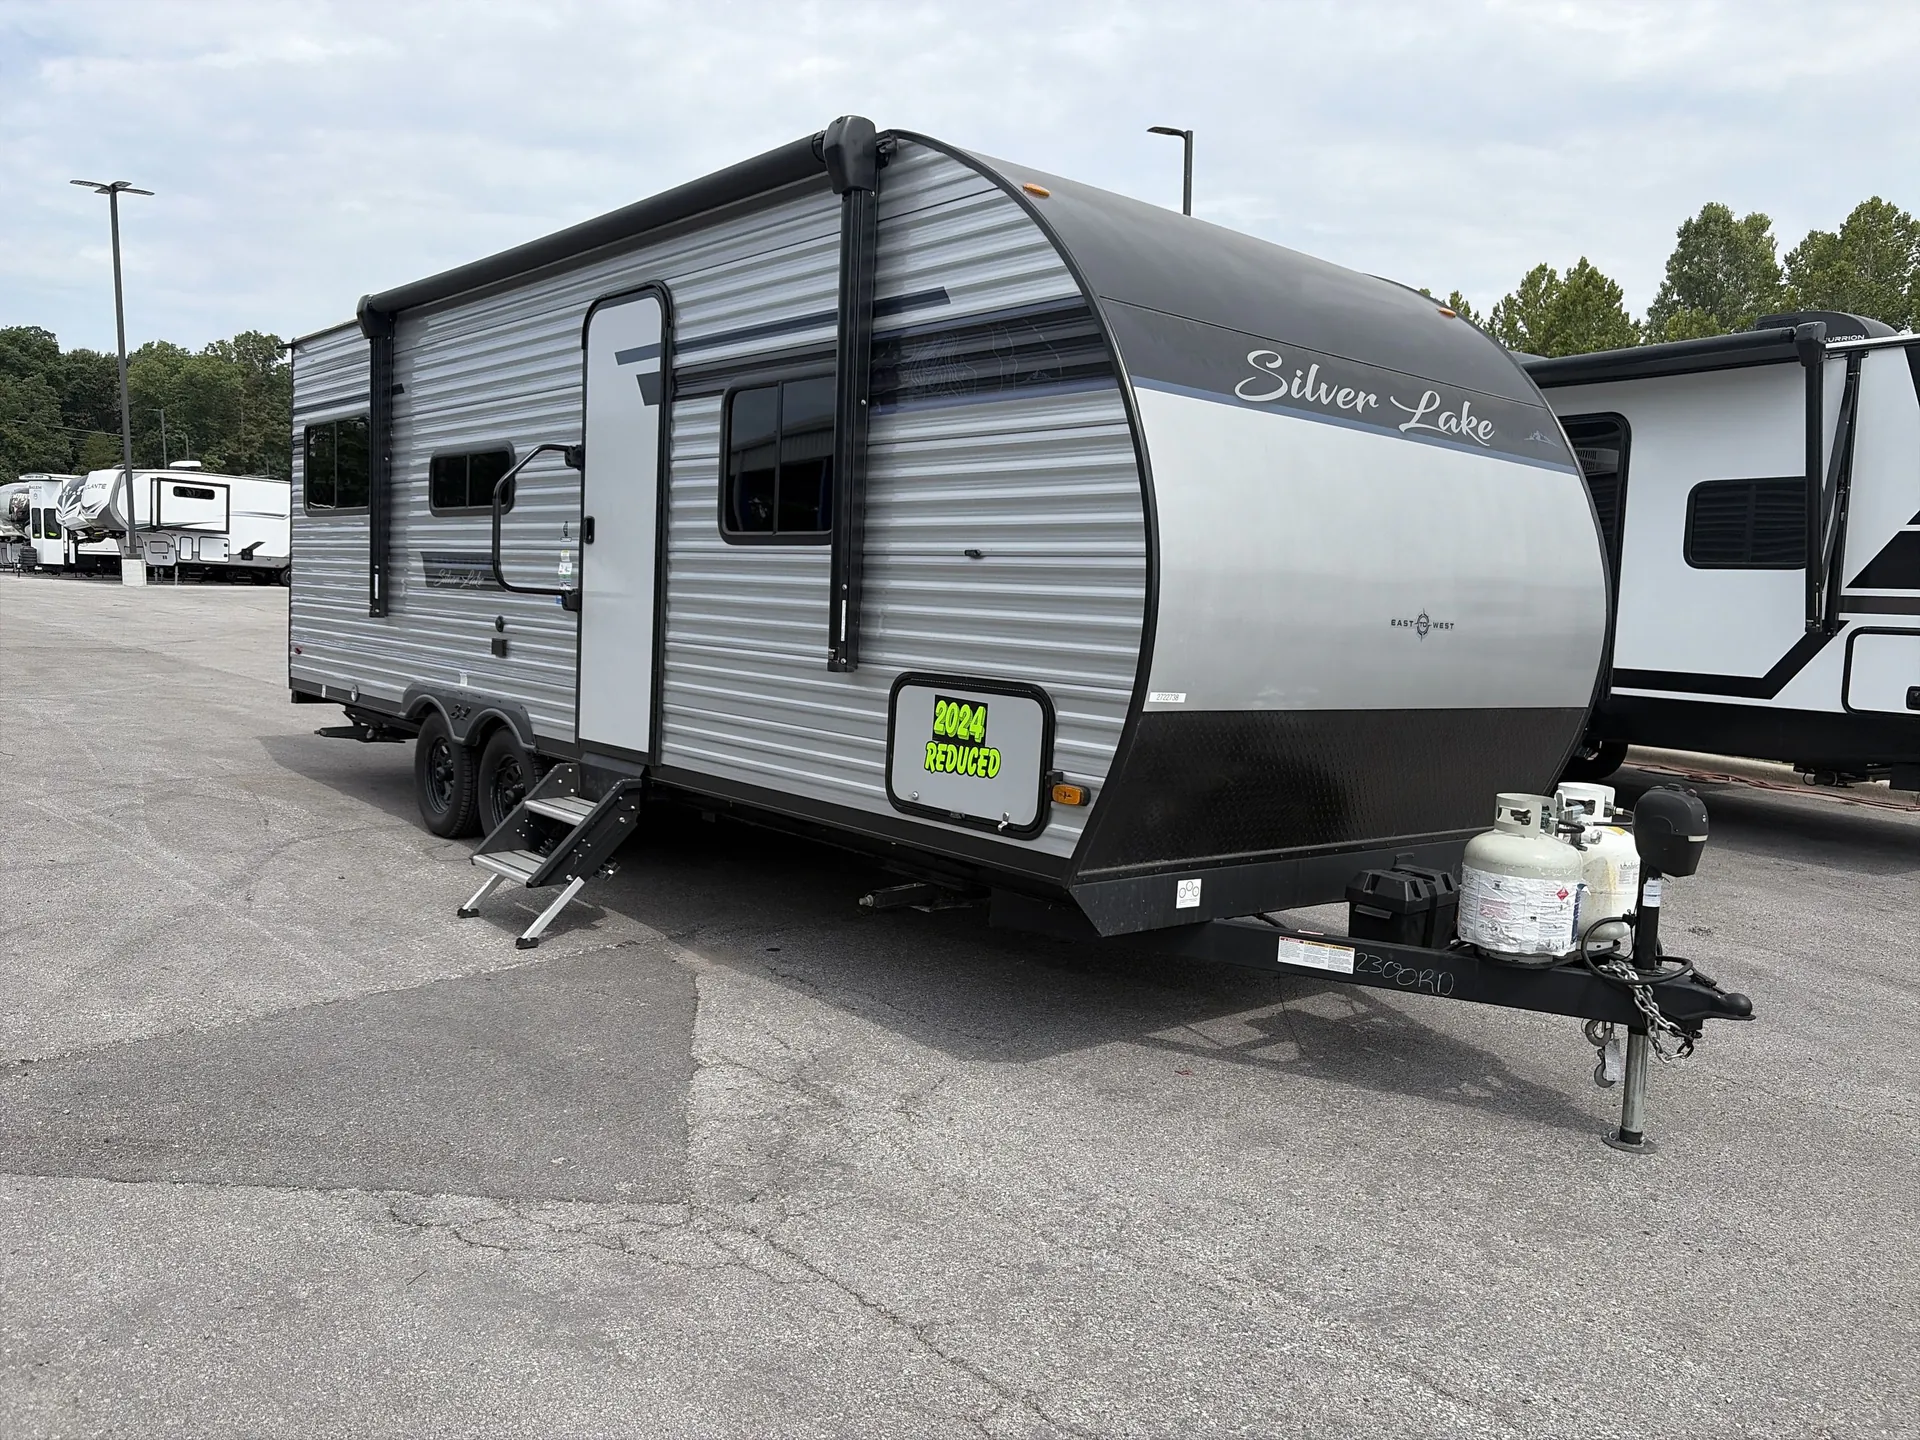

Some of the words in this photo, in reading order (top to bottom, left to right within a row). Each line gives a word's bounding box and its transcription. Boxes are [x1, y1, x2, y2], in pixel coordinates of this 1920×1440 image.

[1234, 350, 1379, 413] Silver
[1390, 390, 1495, 447] Lake
[1390, 619, 1414, 628] EAST
[1432, 622, 1455, 630] WEST
[934, 700, 986, 743] 2024
[924, 741, 1001, 778] REDUCED
[1356, 952, 1455, 996] 2300RD
